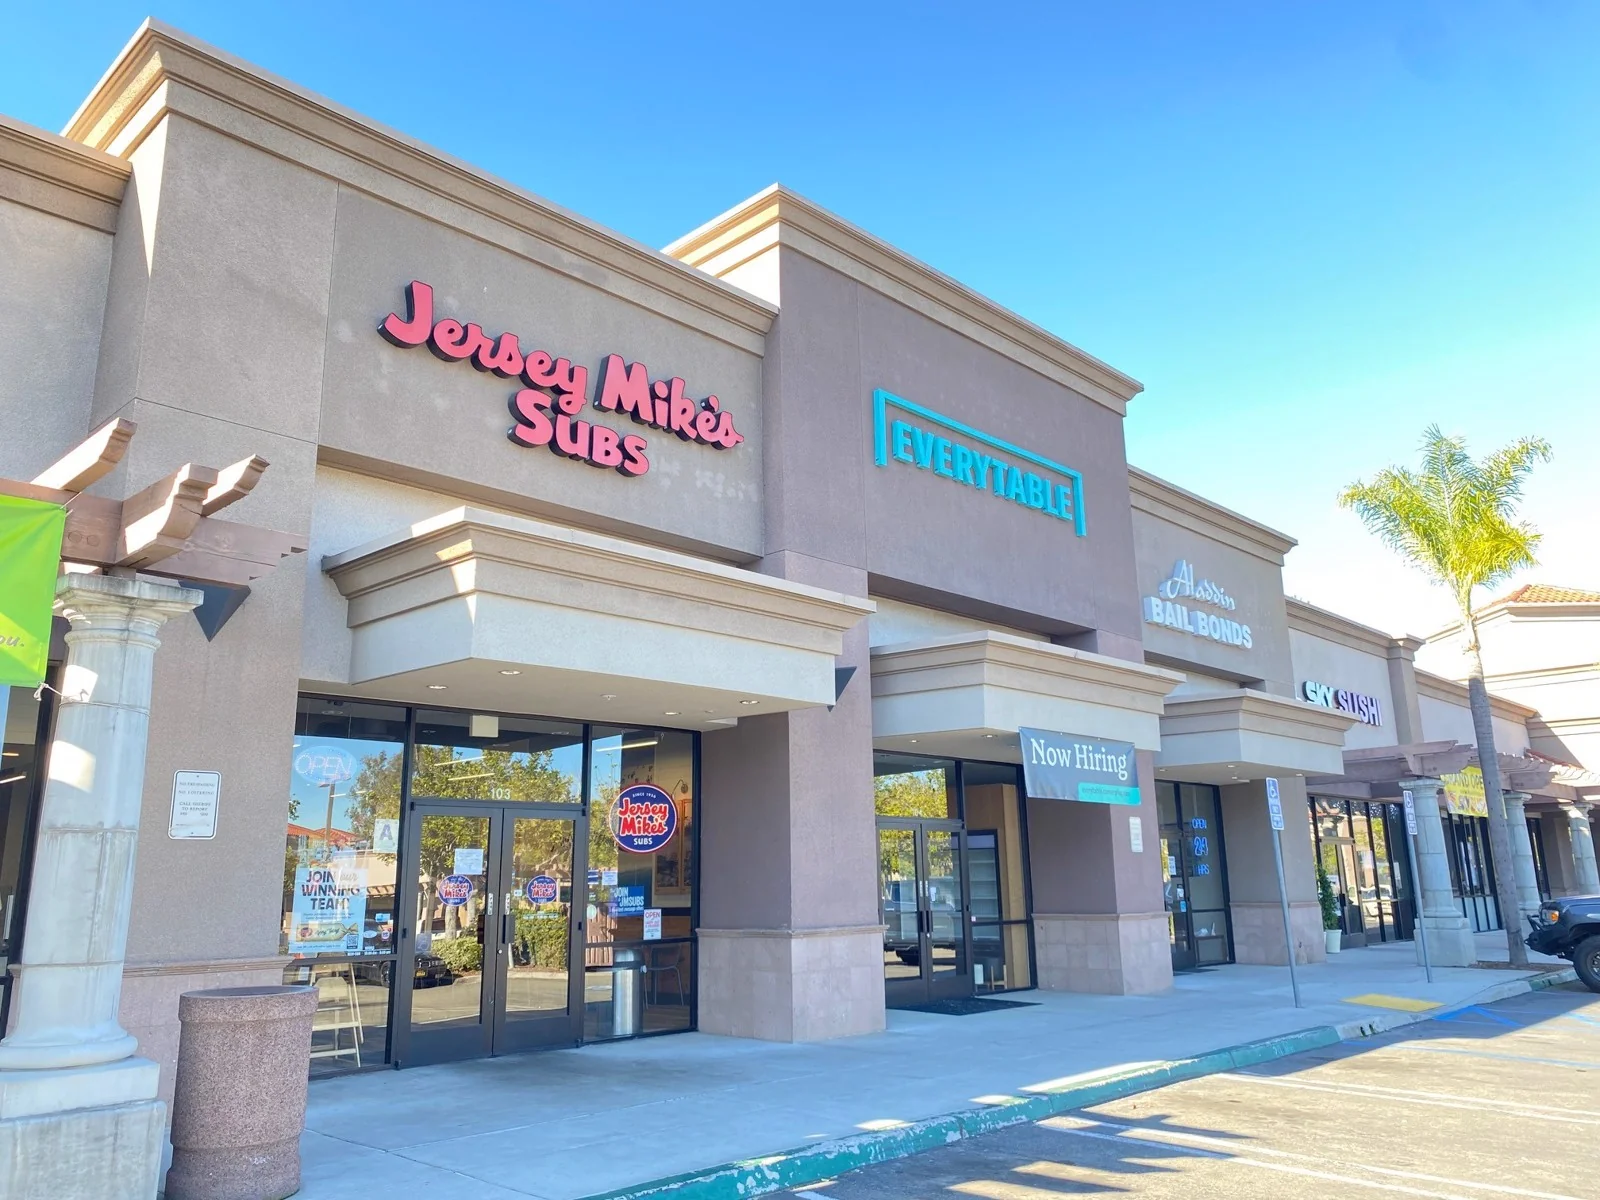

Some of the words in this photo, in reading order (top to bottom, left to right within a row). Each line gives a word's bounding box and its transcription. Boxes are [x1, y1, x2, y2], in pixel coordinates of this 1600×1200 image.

[378, 280, 588, 415] Jersey
[594, 354, 745, 450] Mike's
[891, 420, 1073, 521] EVERYTABLE
[1160, 559, 1236, 610] Aladdin
[1144, 596, 1194, 633] BAIL
[1191, 610, 1253, 649] BONDS
[1303, 680, 1333, 708] SKY
[1336, 689, 1382, 727] SUSHI
[294, 752, 352, 778] OPEN
[1031, 738, 1072, 768] Now
[1074, 744, 1128, 781] Hiring
[490, 788, 511, 800] 103
[618, 798, 668, 821] Jersey
[380, 824, 393, 841] A
[620, 816, 668, 836] Mike's
[1192, 818, 1207, 829] OPEN
[633, 837, 653, 845] SUBS
[1194, 836, 1208, 856] 24
[306, 871, 335, 883] JOIN
[1198, 863, 1210, 875] HRS
[443, 880, 470, 890] Jersey
[531, 880, 556, 891] Jersey
[613, 887, 629, 897] JOIN
